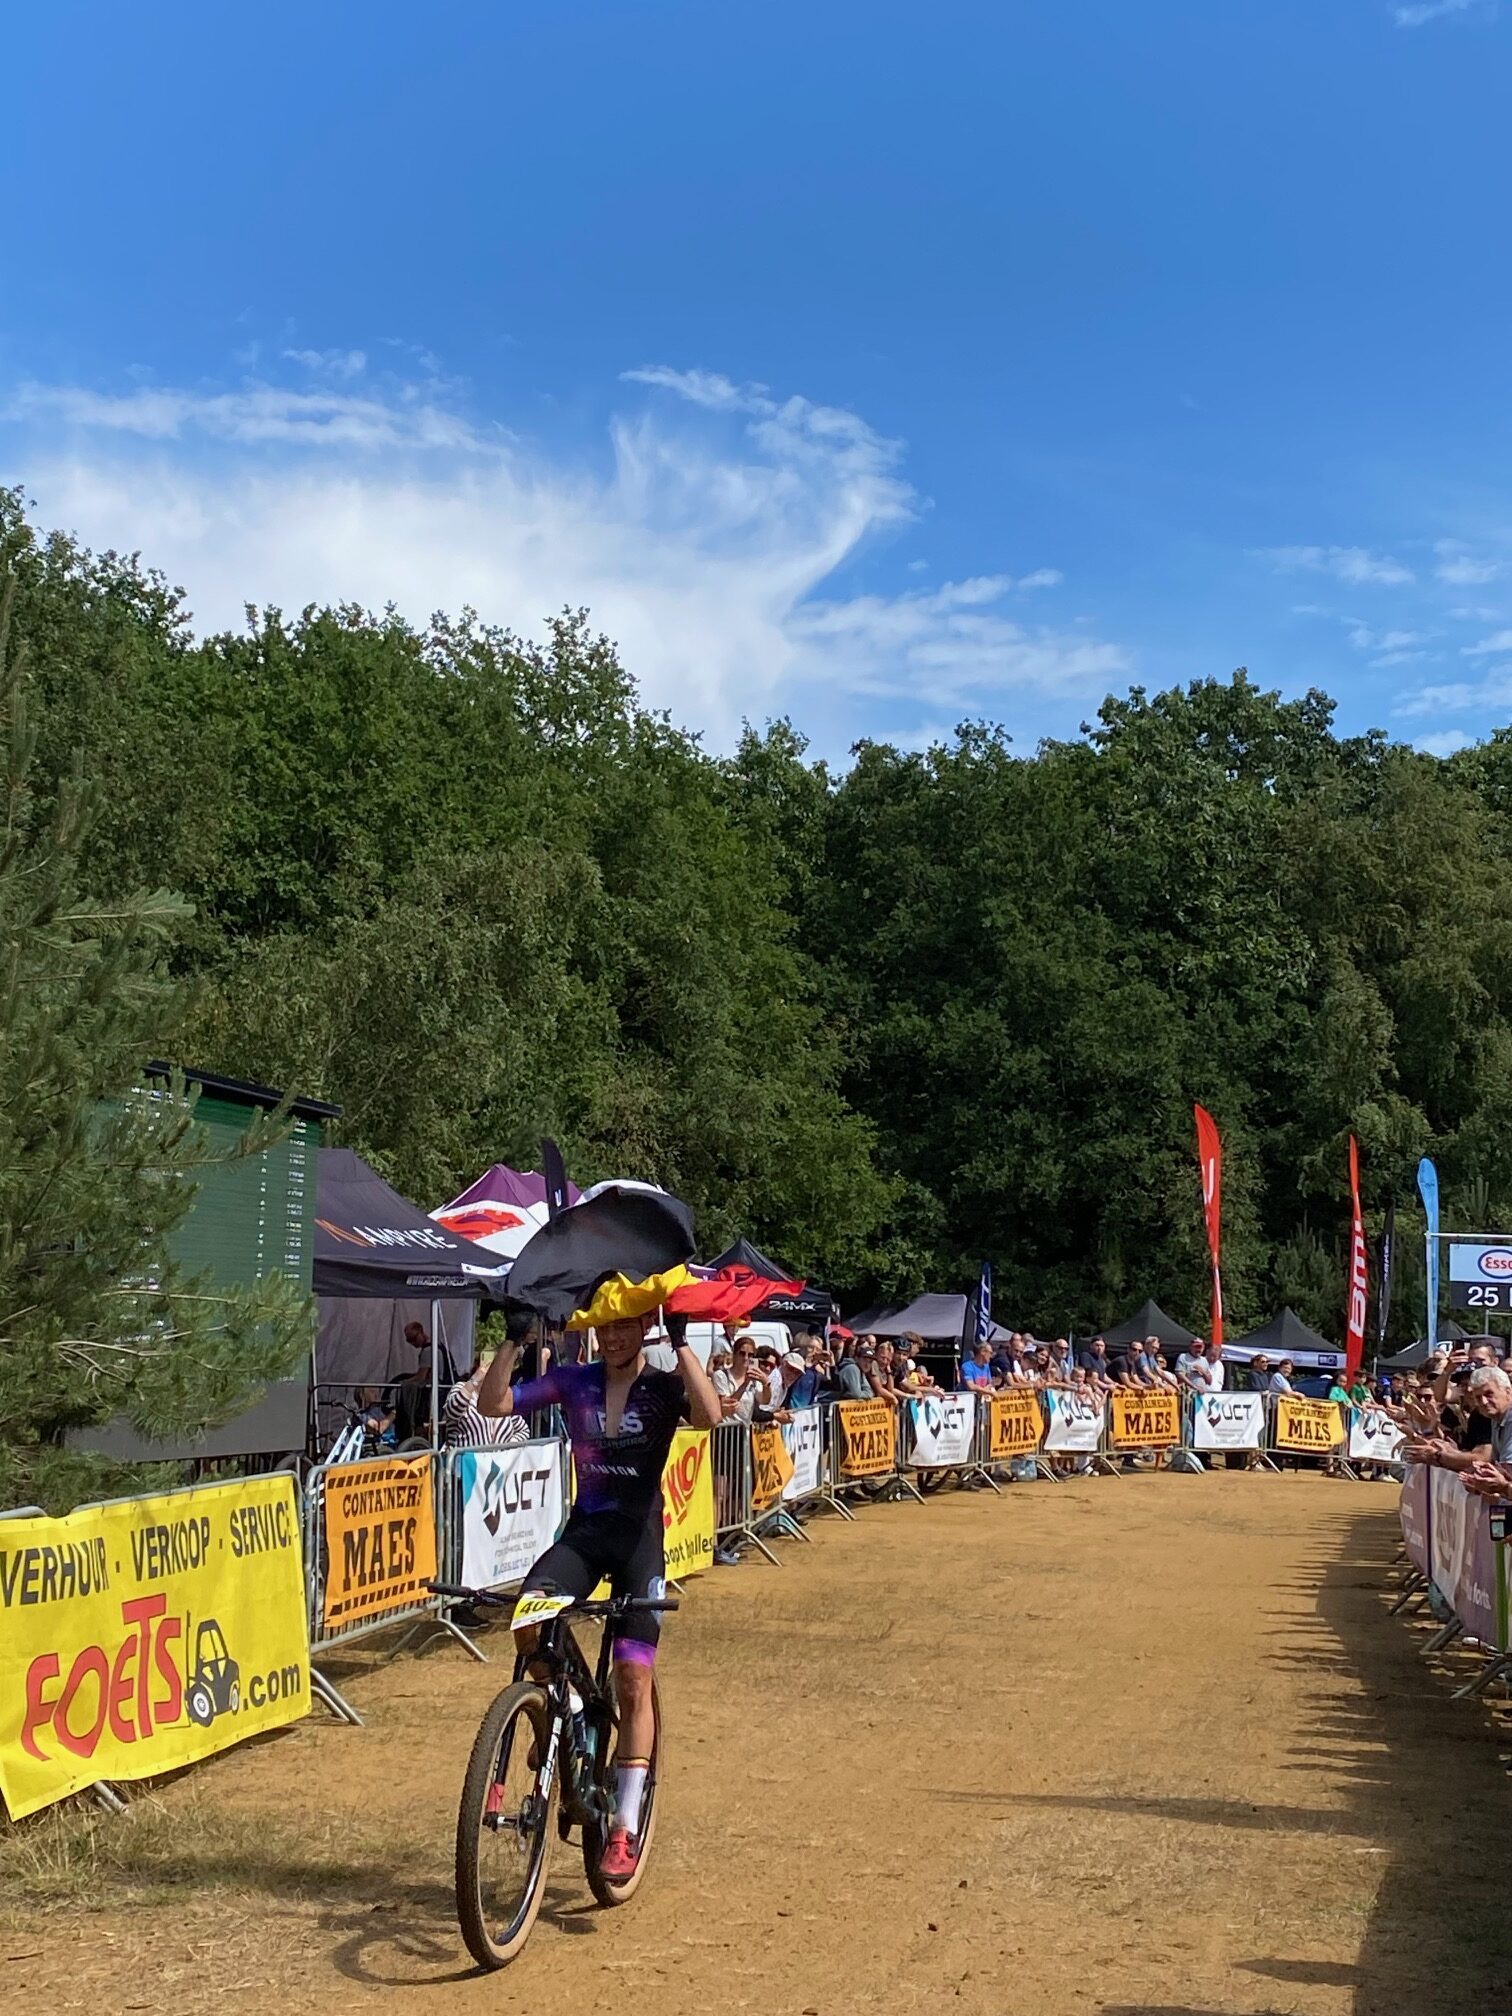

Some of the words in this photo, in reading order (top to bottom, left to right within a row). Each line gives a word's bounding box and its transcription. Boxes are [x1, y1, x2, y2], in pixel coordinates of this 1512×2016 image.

[769, 1300, 816, 1311] 24MX
[1467, 1286, 1499, 1307] 25
[1124, 1412, 1172, 1435] MAES
[1222, 1404, 1252, 1421] UCT
[1288, 1418, 1331, 1441] MAES
[503, 1469, 551, 1514] UCT
[0, 1537, 110, 1609] VERHUUR
[130, 1516, 210, 1582] VERKOOP
[343, 1516, 418, 1593] MAES
[20, 1593, 182, 1762] FOETS
[243, 1663, 301, 1711] .com
